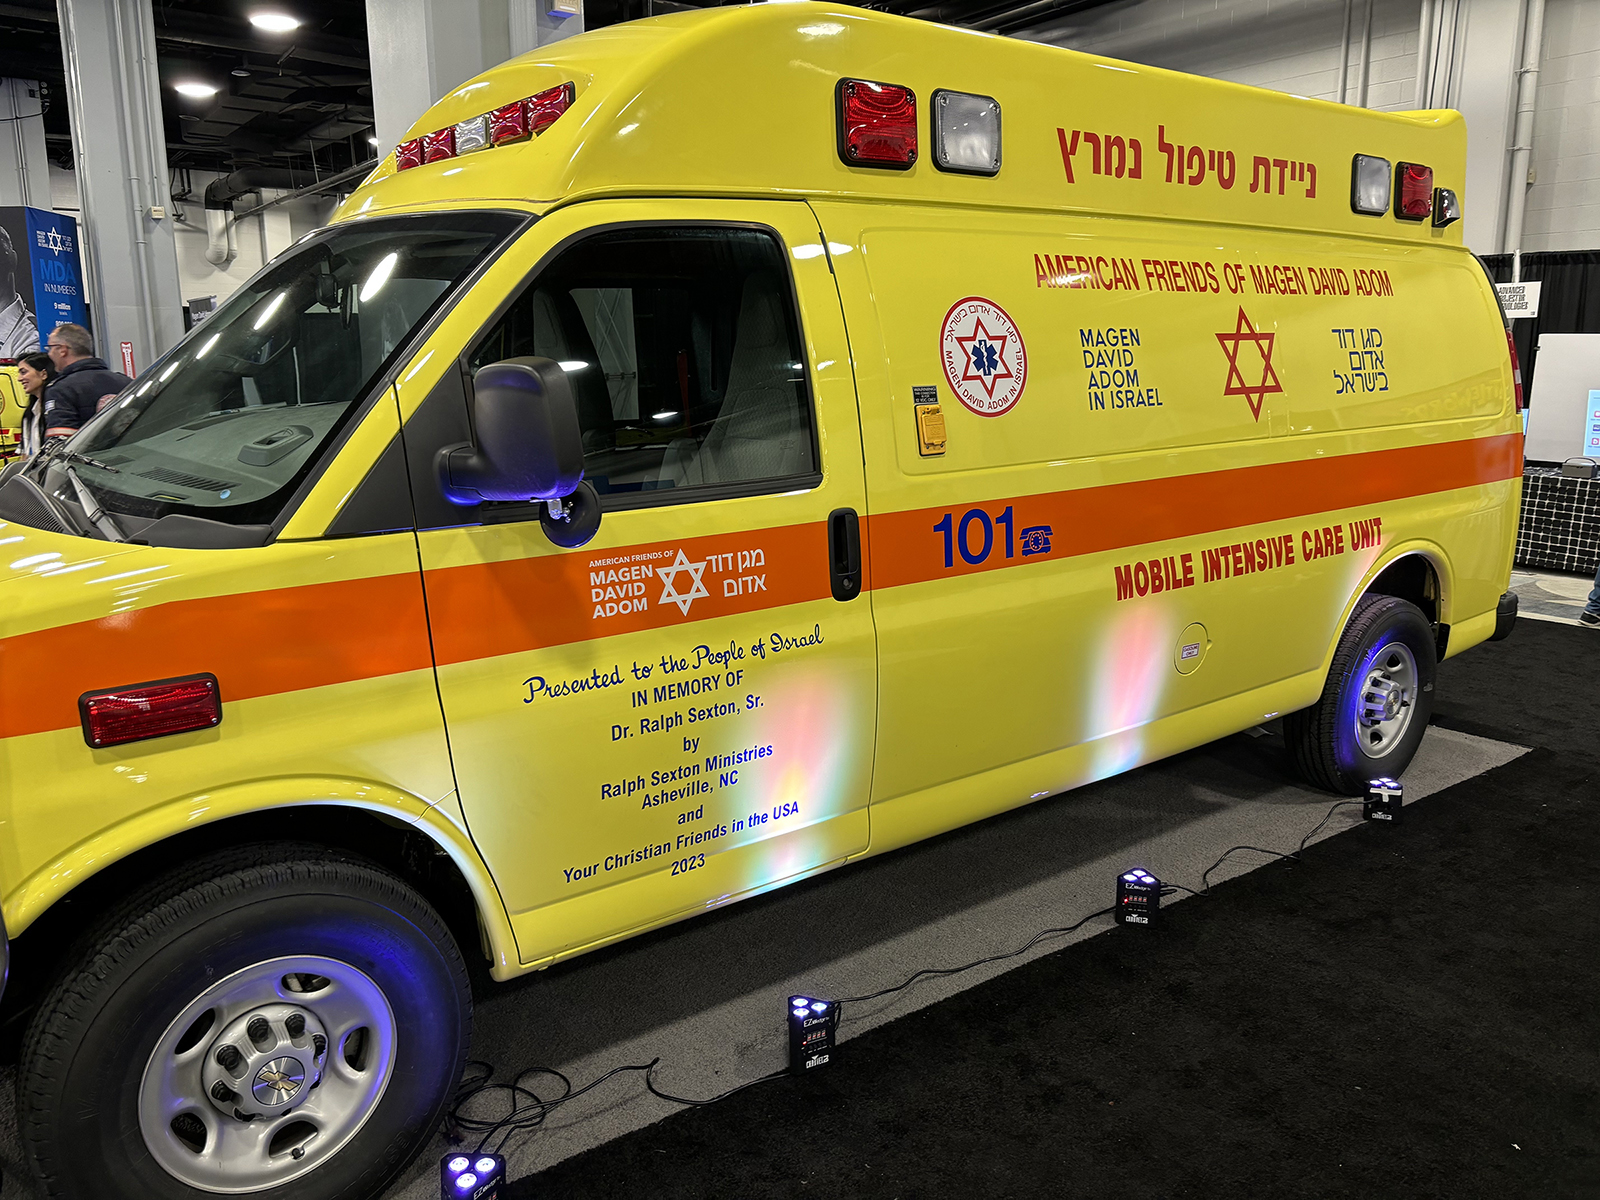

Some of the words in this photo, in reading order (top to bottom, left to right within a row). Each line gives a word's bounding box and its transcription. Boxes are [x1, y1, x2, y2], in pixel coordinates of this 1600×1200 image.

[1056, 127, 1143, 184] נמרץ
[1157, 124, 1236, 190] טיפול
[1249, 155, 1317, 198] ניידת
[39, 259, 76, 284] MDA
[1034, 253, 1140, 292] AMERICAN
[1144, 259, 1220, 295] FRIENDS
[1223, 262, 1245, 294] OF
[1250, 265, 1308, 295] MAGEN
[1310, 267, 1351, 297] DAVID
[1354, 269, 1395, 298] ADOM
[51, 284, 77, 296] NUMBERS
[968, 305, 991, 315] אדום
[993, 310, 1006, 326] דוד
[945, 308, 968, 342] בישראל
[1006, 326, 1018, 344] מגן
[1079, 328, 1141, 347] MAGEN
[1331, 328, 1356, 349] דוד
[1363, 328, 1383, 350] מגן
[1083, 349, 1134, 369] DAVID
[1349, 350, 1385, 371] אדום
[945, 350, 963, 389] MAGEN
[962, 389, 985, 409] DAVID
[987, 395, 1010, 410] ADOM
[1008, 386, 1017, 397] IN
[1014, 347, 1023, 385] ISRAEL
[1088, 369, 1140, 390] ADOM
[1333, 370, 1389, 395] בישראל
[1089, 391, 1106, 411] IN
[1110, 388, 1163, 409] ISRAEL
[932, 506, 1014, 568] 101
[589, 555, 630, 568] AMERICAN
[631, 551, 663, 562] FRIENDS
[706, 553, 733, 573] דוד
[737, 548, 765, 573] מגן
[1114, 553, 1195, 601] MOBILE
[1201, 534, 1295, 583] INTENSIVE
[1301, 525, 1344, 562] CARE
[1349, 517, 1382, 551] UNIT
[590, 565, 653, 586] MAGEN
[723, 574, 767, 597] אדום
[591, 582, 646, 602] DAVID
[592, 597, 648, 619] ADOM
[522, 665, 625, 704] Presented
[631, 661, 654, 681] to
[659, 655, 690, 676] the
[691, 640, 746, 670] People
[751, 638, 766, 659] of
[770, 623, 825, 653] Israel
[631, 690, 648, 708] IN
[653, 673, 721, 704] MEMORY
[726, 670, 744, 688] OF
[611, 724, 634, 741] Dr.
[640, 711, 683, 735] Ralph
[688, 702, 741, 724] Sexton,
[746, 694, 764, 709] Sr.
[683, 735, 701, 753] by
[601, 776, 645, 800] Ralph
[650, 762, 700, 787] Sexton
[705, 743, 773, 772] Ministries
[641, 783, 714, 810] Asheville,
[719, 770, 739, 788] NC
[677, 805, 703, 825] and
[563, 862, 600, 883] Your
[604, 843, 671, 872] Christian
[676, 825, 727, 850] Friends
[732, 819, 744, 833] in
[748, 811, 768, 828] the
[772, 801, 799, 820] USA
[671, 853, 706, 877] 2023
